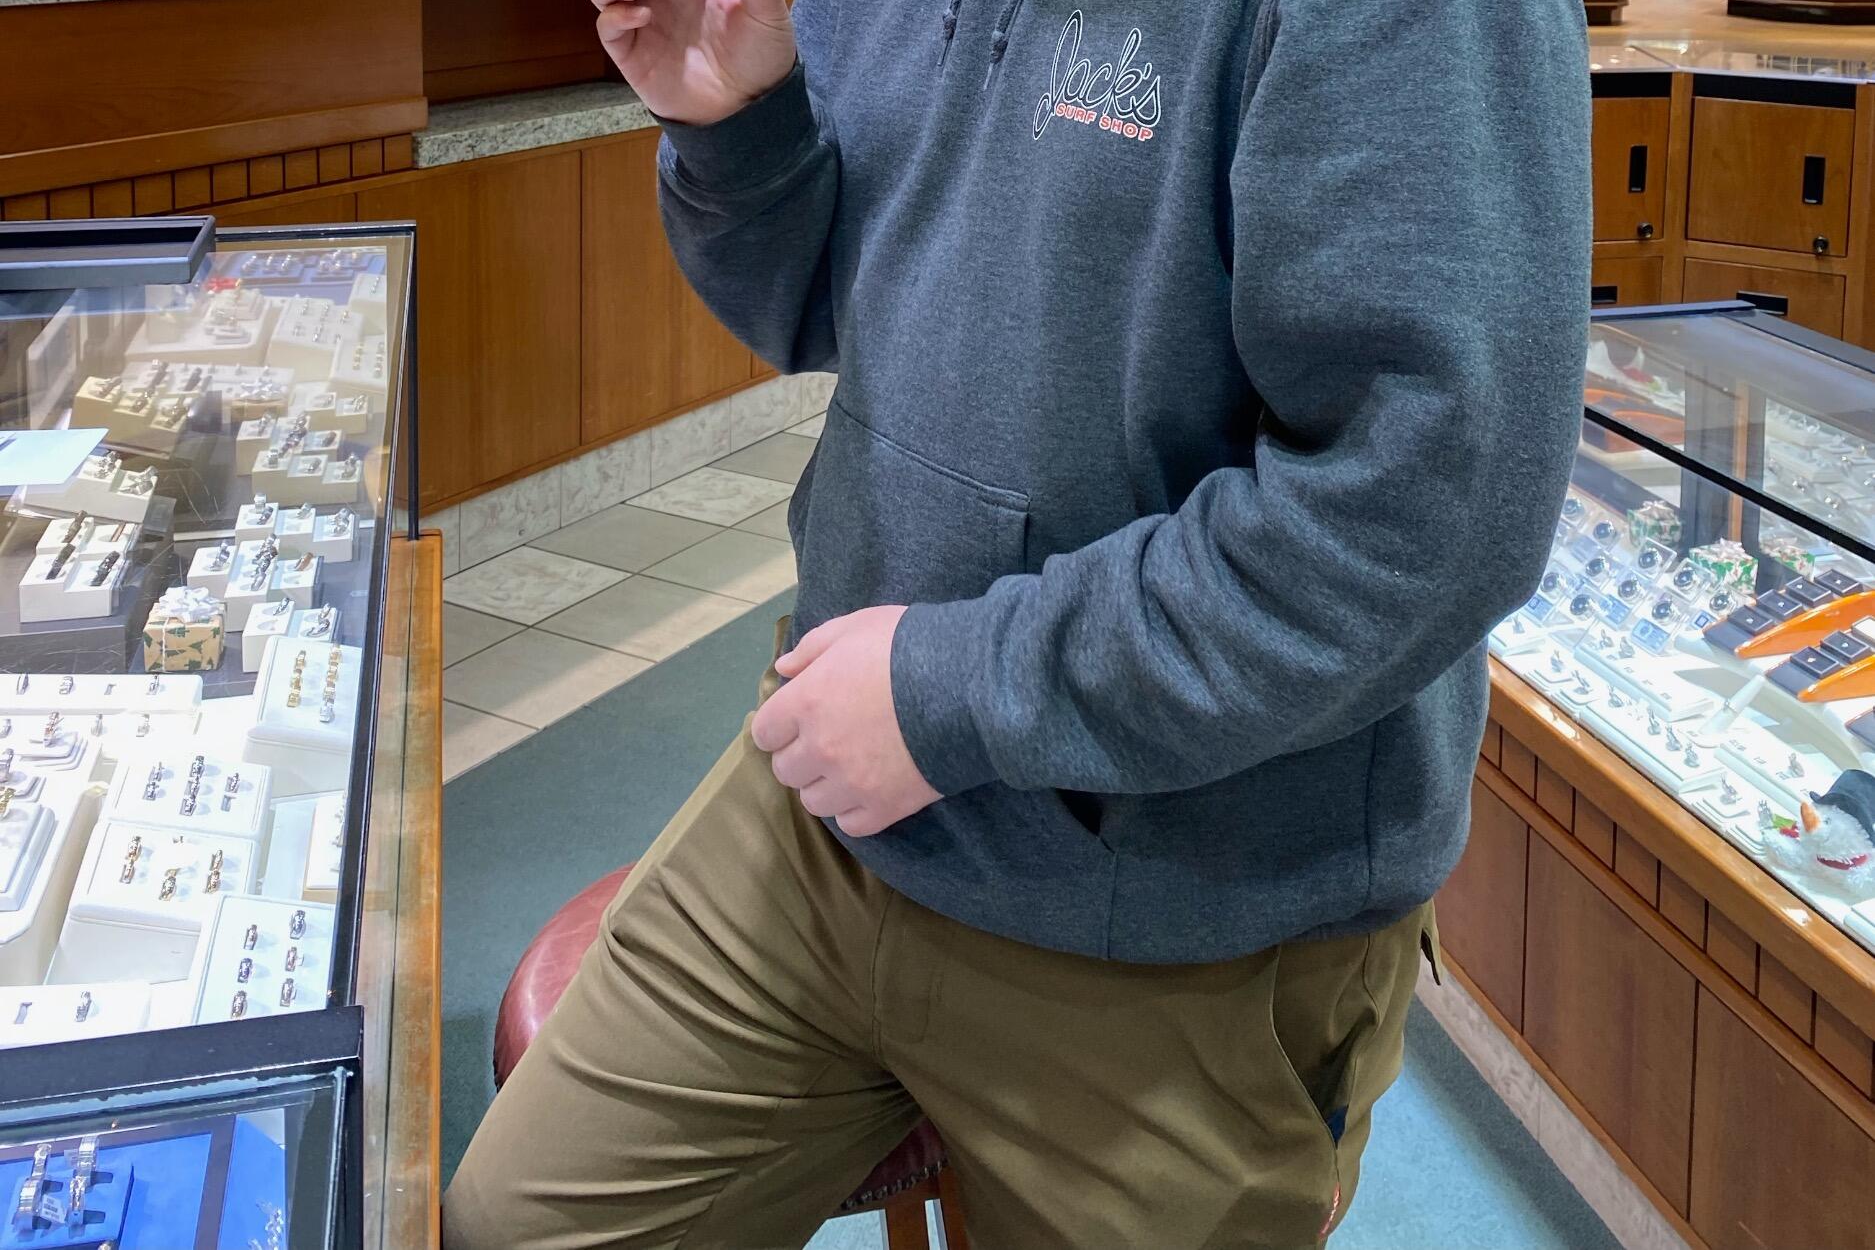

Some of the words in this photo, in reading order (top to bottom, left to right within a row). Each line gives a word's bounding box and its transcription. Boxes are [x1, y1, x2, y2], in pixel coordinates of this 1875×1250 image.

[1033, 9, 1161, 140] Jack's
[1056, 103, 1097, 125] SURF
[1099, 115, 1154, 142] SHOP
